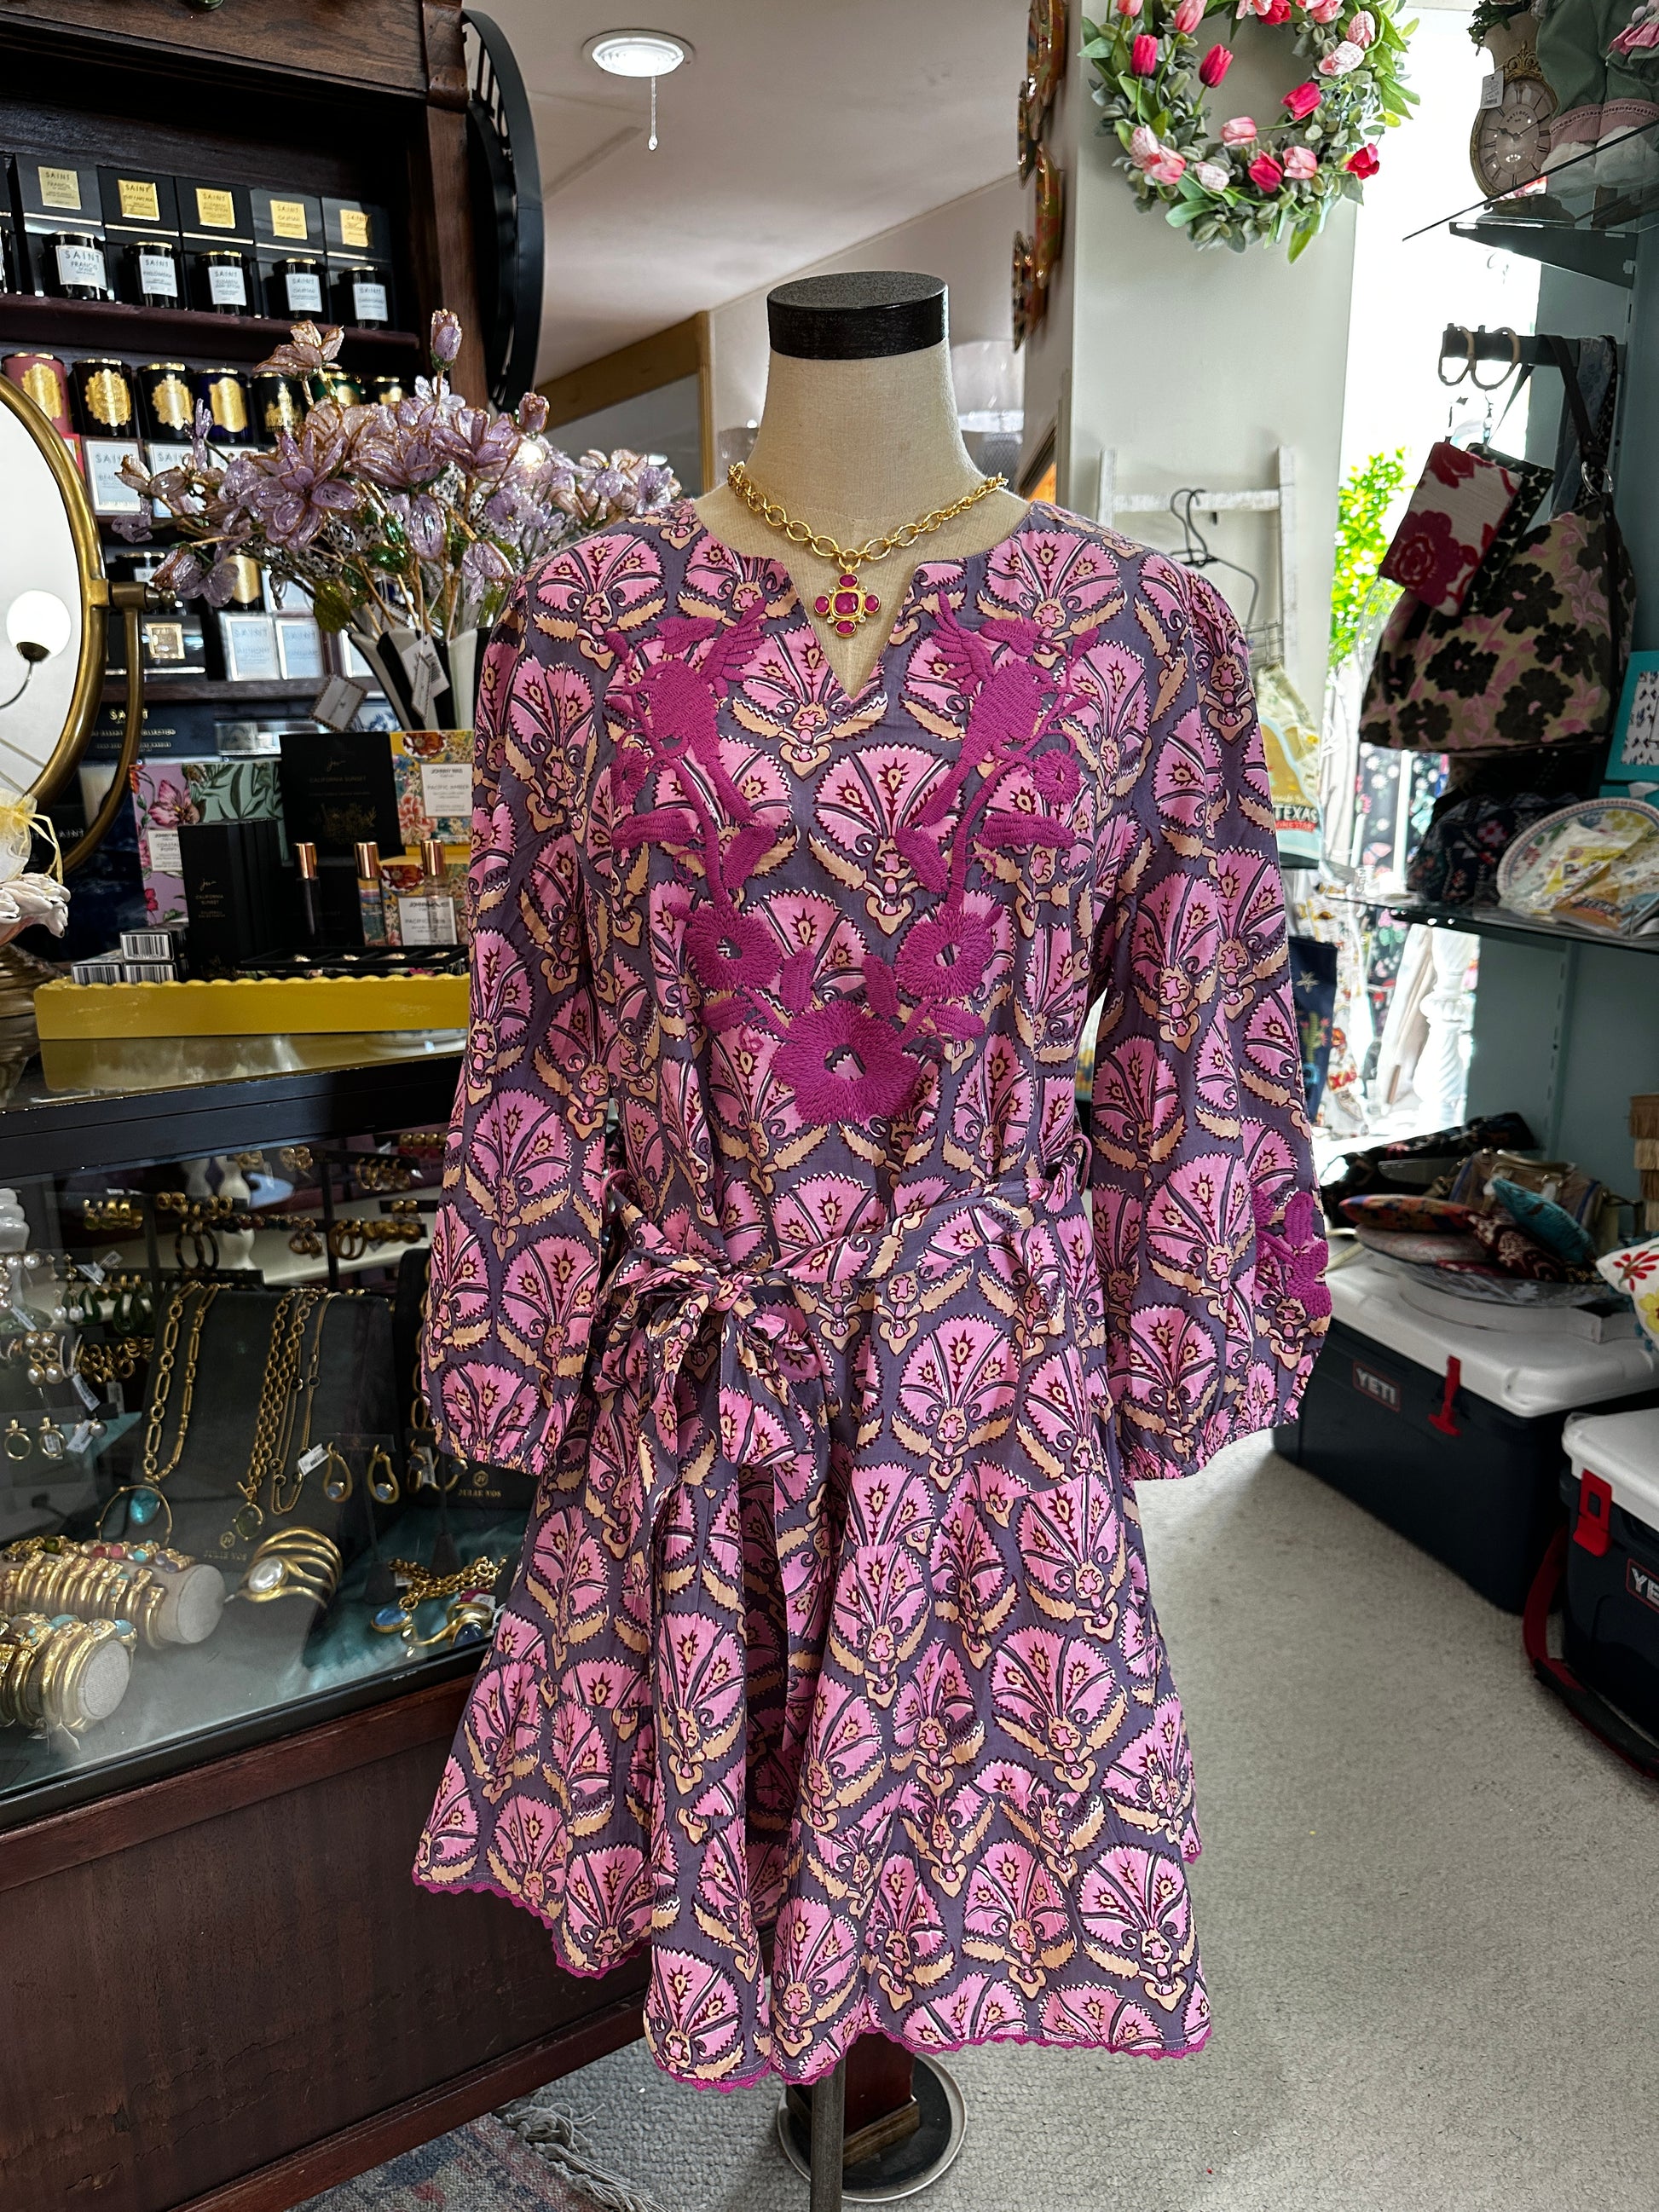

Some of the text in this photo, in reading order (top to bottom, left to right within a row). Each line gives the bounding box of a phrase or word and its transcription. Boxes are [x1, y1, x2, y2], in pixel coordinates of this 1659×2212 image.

[45, 171, 70, 181] SAINT
[125, 183, 151, 193] SAINT
[202, 192, 226, 201] SAINT
[277, 204, 299, 213] SAINT
[65, 250, 100, 263] SAINT
[145, 259, 169, 268] SAINT
[1273, 804, 1318, 824] TEXAS
[1356, 1367, 1396, 1405] YETI
